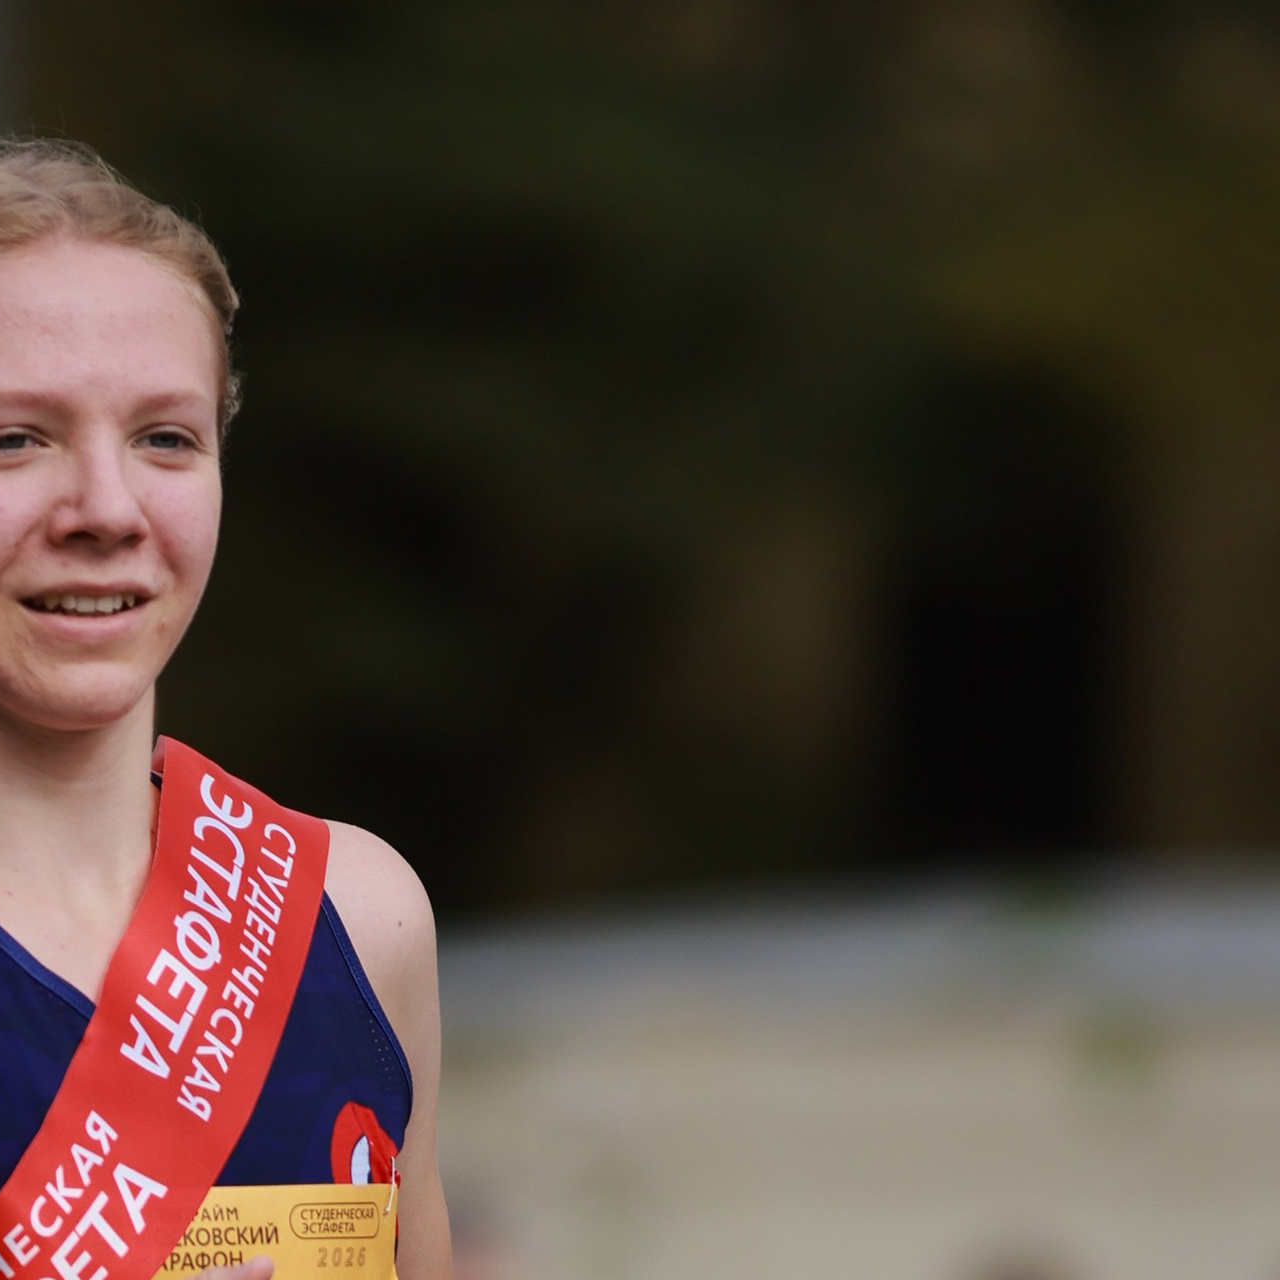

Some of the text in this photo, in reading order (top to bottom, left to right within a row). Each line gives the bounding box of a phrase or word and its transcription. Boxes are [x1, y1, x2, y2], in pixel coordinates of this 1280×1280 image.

[120, 773, 253, 1078] ЭСТАФЕТА
[177, 822, 297, 1121] СТУДЕНЧЕСКАЯ
[192, 1203, 239, 1221] АЙМ
[300, 1207, 375, 1221] СТУДЕНЧЕСКАЯ
[175, 1221, 280, 1247] КОВСКИЙ
[301, 1221, 355, 1234] ЭСТАФЕТА
[317, 1246, 367, 1268] 2026
